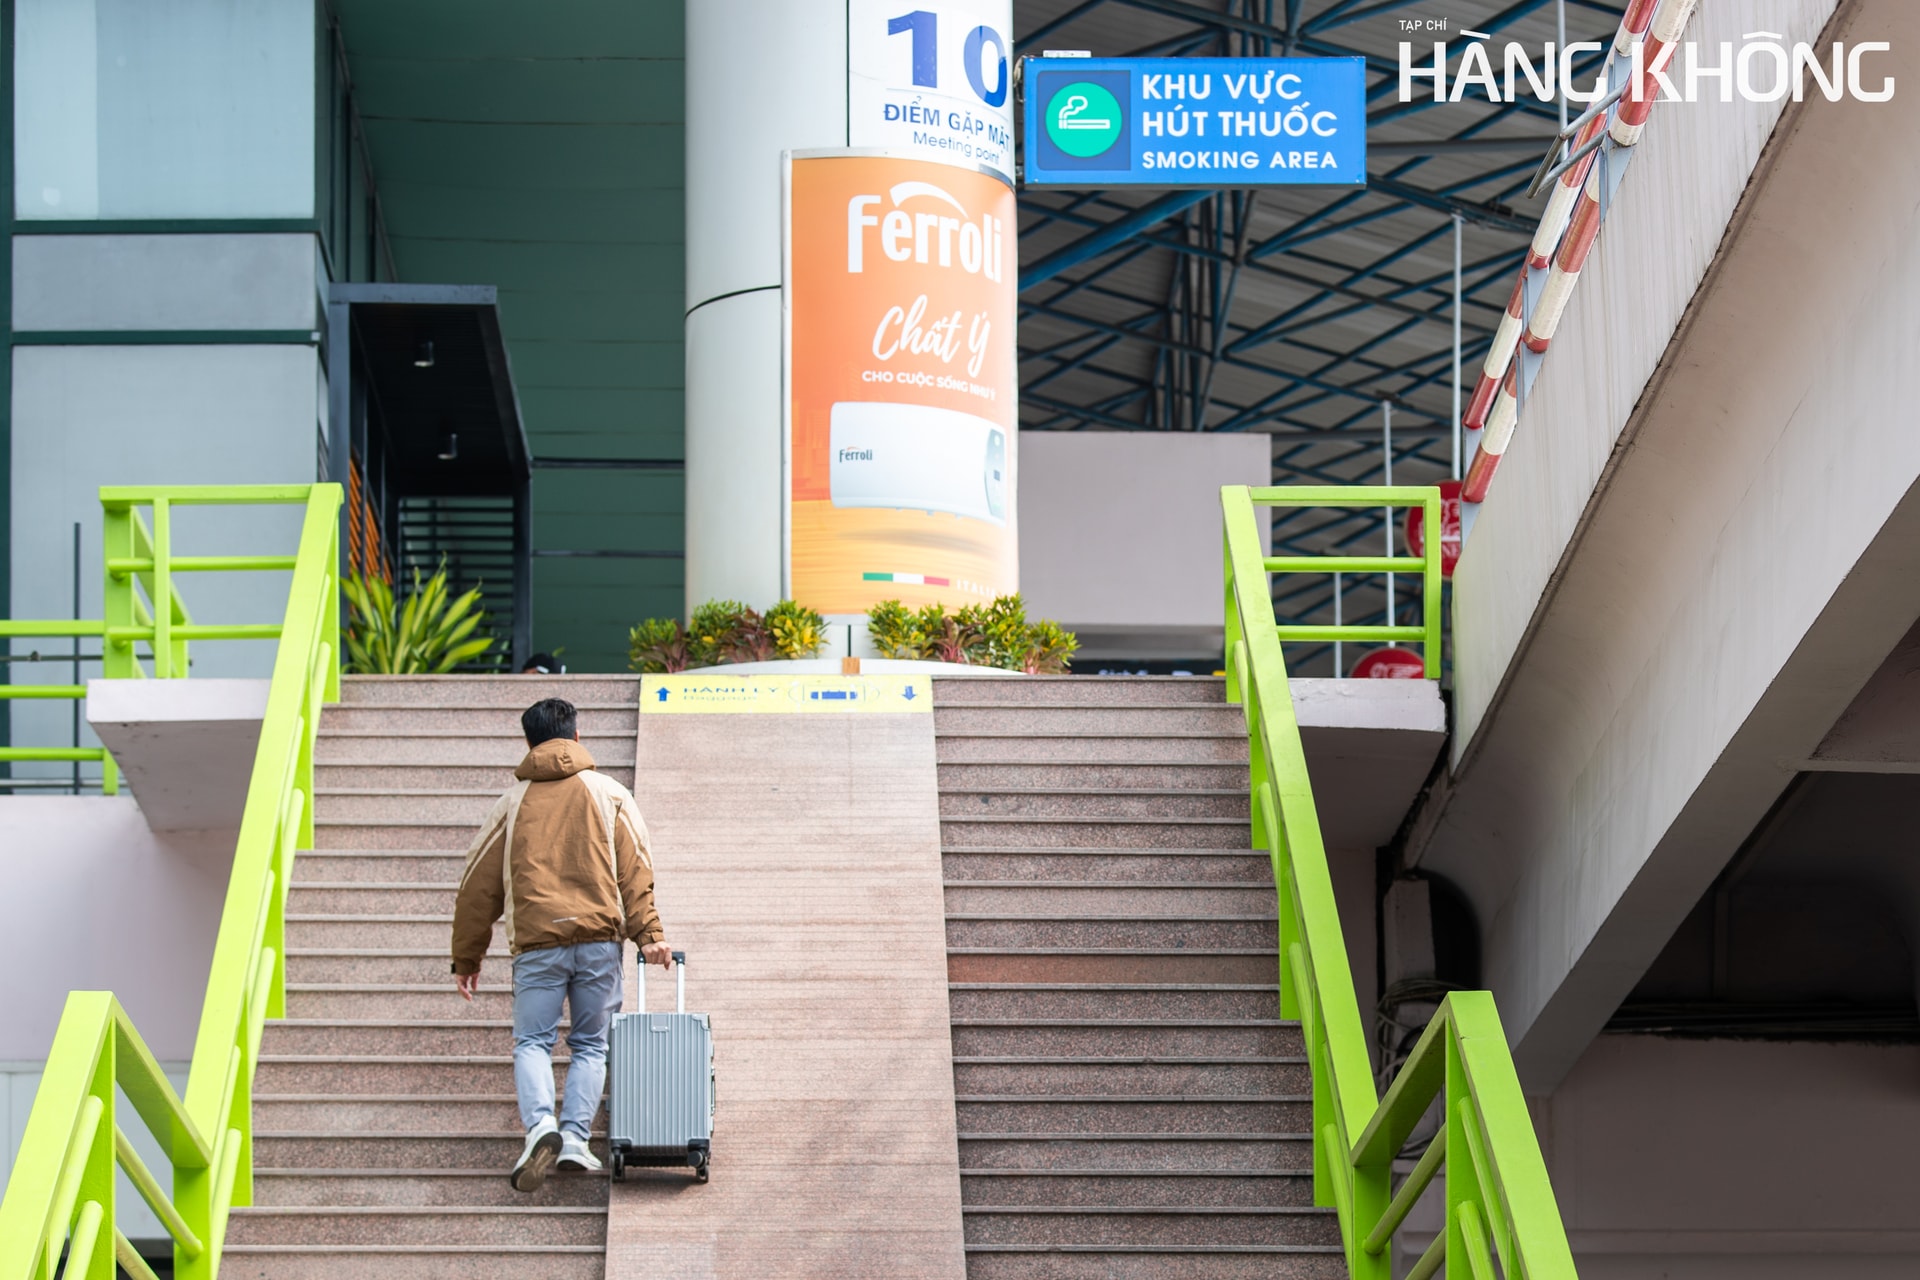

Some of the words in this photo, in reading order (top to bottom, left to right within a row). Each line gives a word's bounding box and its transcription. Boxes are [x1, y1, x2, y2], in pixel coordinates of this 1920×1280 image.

[888, 10, 1007, 108] 10
[1142, 74, 1211, 100] KHU
[1223, 70, 1302, 104] VỰC
[883, 95, 940, 127] ĐIỂM
[948, 111, 984, 139] GẶP
[1142, 104, 1208, 137] HÚT
[1218, 101, 1338, 137] THUỐC
[913, 131, 972, 158] Meeting
[975, 147, 1000, 165] point
[1142, 151, 1260, 169] SMOKING
[1269, 151, 1338, 169] AREA
[847, 184, 1002, 284] Ferroli
[872, 294, 962, 363] Chất
[862, 370, 894, 383] CHO
[896, 371, 934, 388] CUỘC
[839, 447, 873, 463] Ferroli
